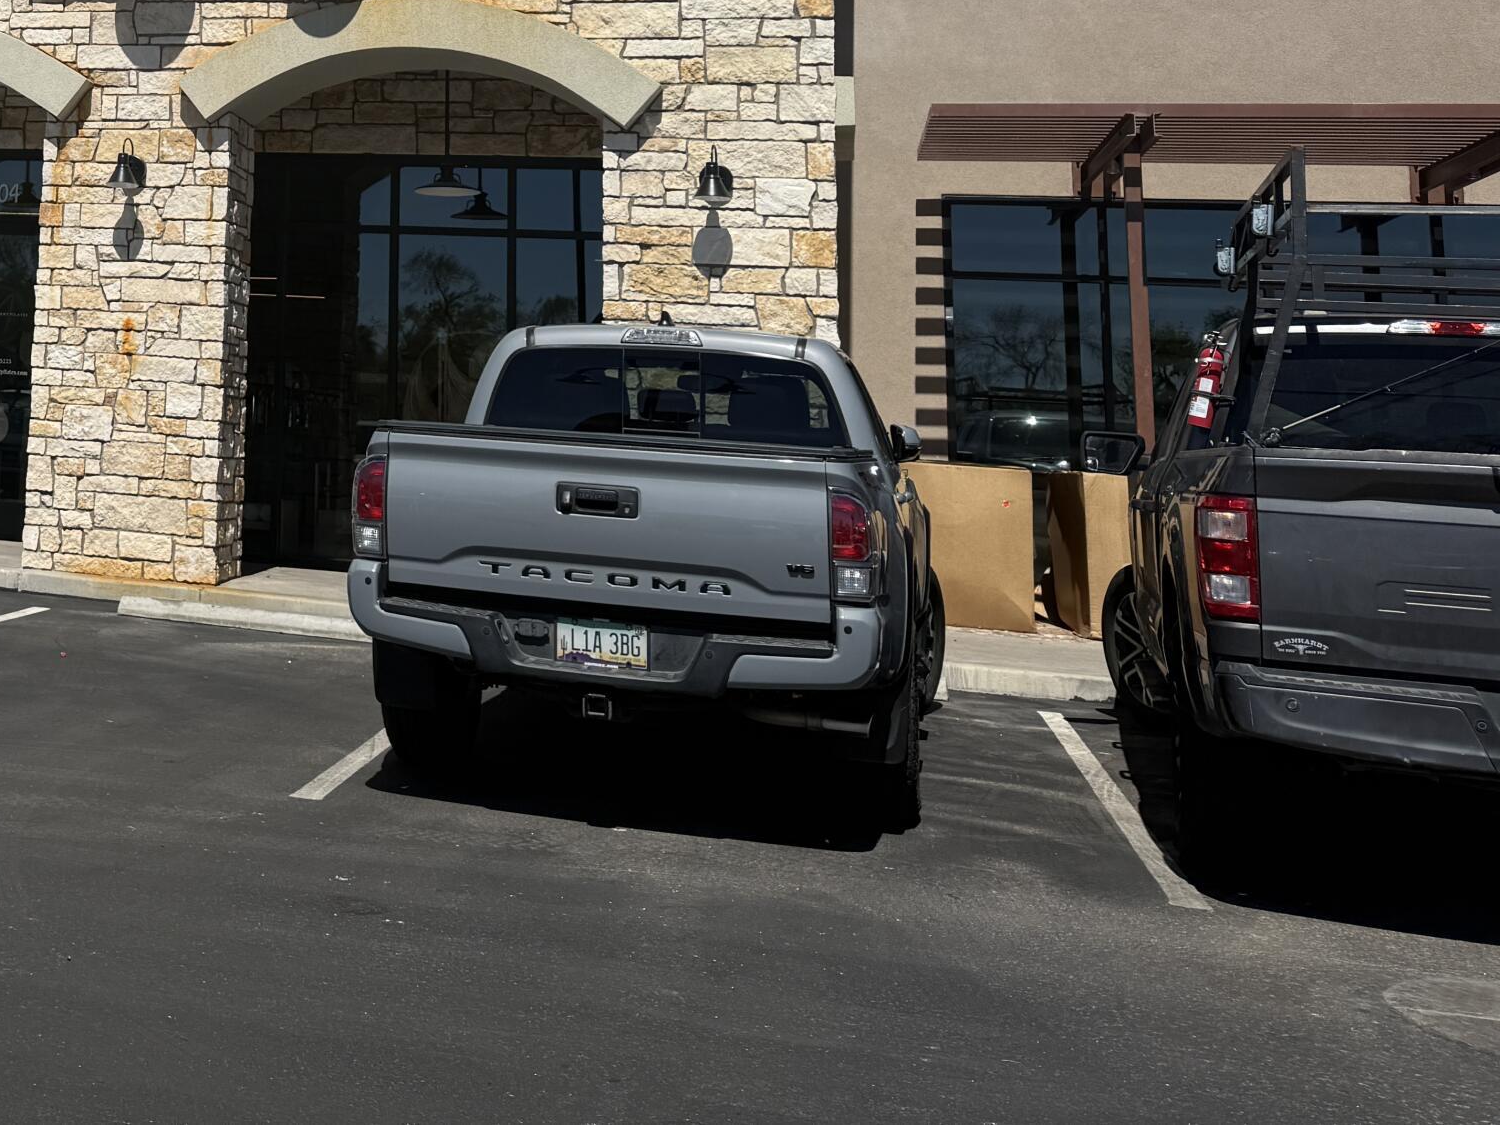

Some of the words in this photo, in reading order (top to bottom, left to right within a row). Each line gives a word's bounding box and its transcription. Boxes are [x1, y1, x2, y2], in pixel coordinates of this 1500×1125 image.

[478, 559, 732, 598] TACOMA
[786, 563, 815, 579] V6
[609, 632, 641, 657] 3BG
